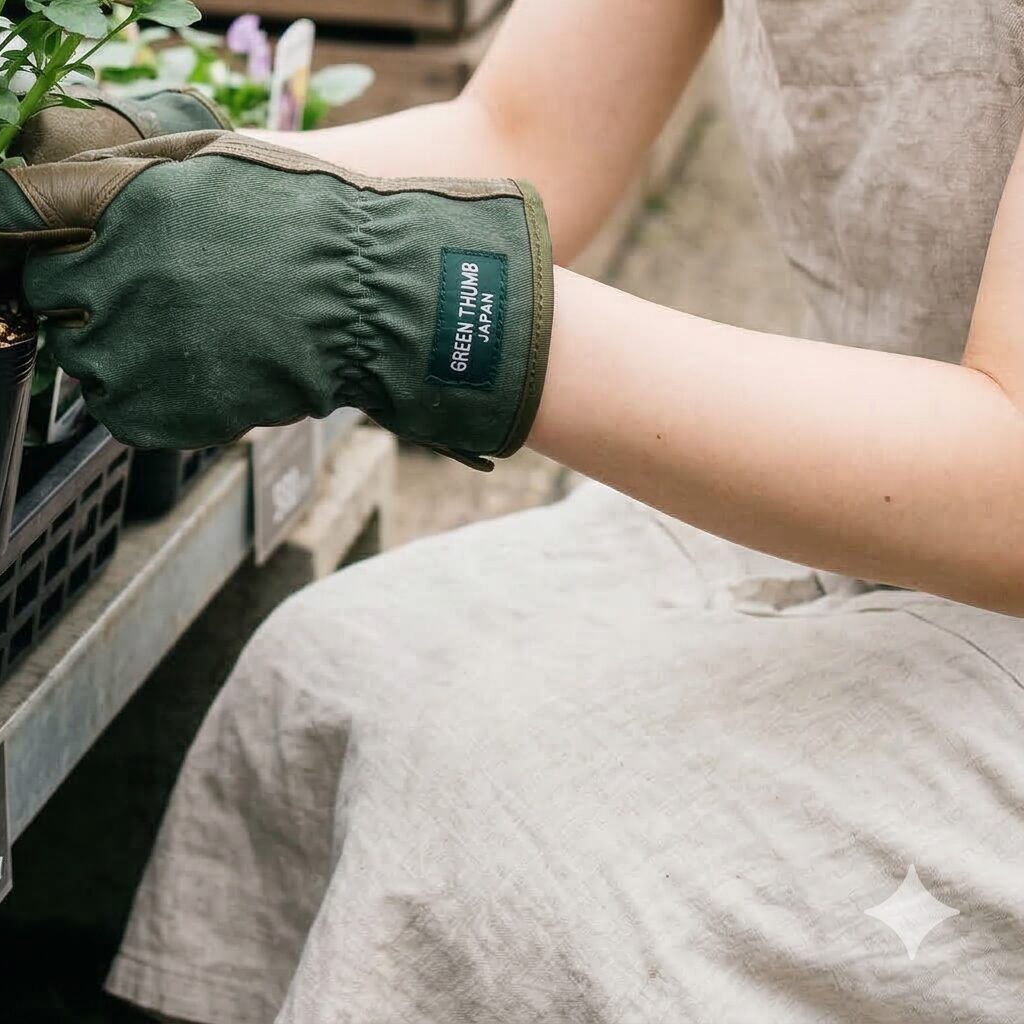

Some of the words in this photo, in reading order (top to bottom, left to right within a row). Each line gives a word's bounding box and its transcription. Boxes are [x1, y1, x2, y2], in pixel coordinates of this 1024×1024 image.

[458, 262, 479, 317] THUMB
[477, 292, 494, 343] JAPAN
[450, 322, 474, 372] GREEN
